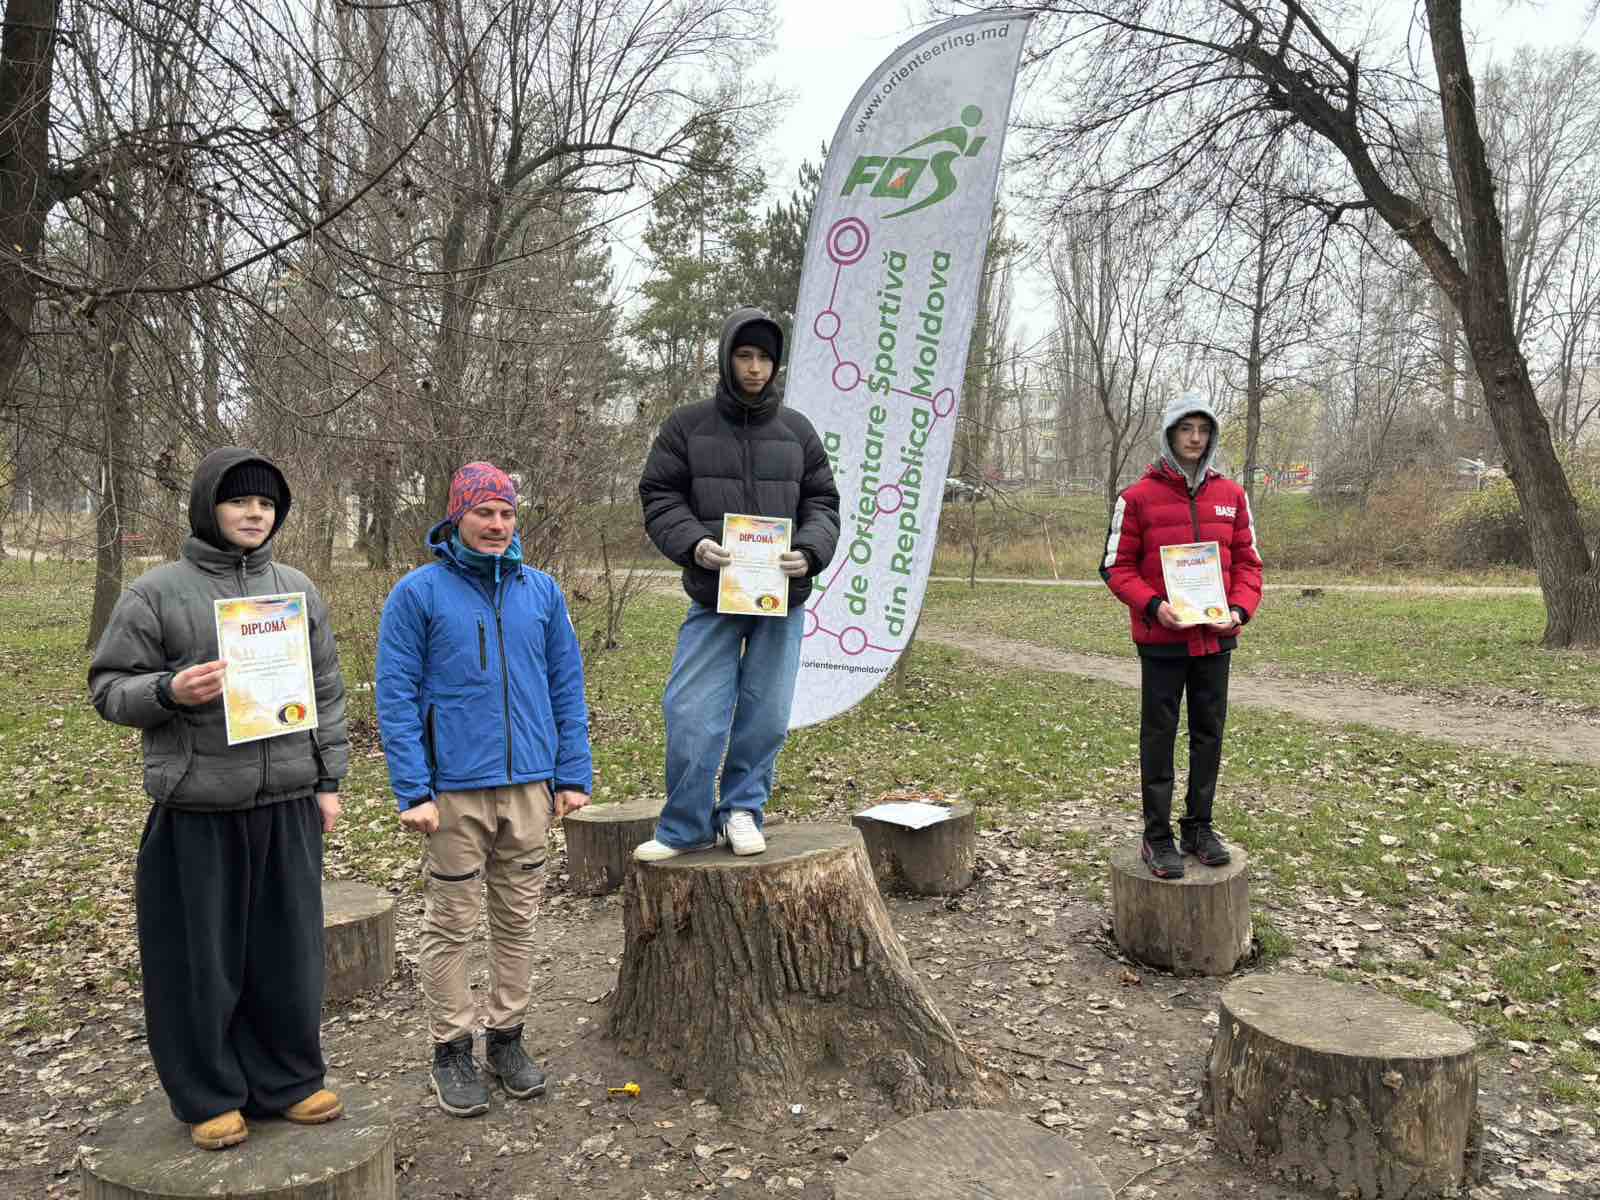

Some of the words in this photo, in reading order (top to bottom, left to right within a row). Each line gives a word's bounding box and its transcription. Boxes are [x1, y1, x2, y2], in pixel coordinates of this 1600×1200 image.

[854, 24, 1009, 135] www.orienteering.md
[868, 251, 908, 396] Sportivă
[911, 250, 951, 397] Moldova
[849, 405, 888, 566] Orientare
[890, 407, 930, 575] Republica
[241, 617, 288, 636] DIPLOMĂ
[844, 574, 868, 616] de
[884, 586, 908, 637] din
